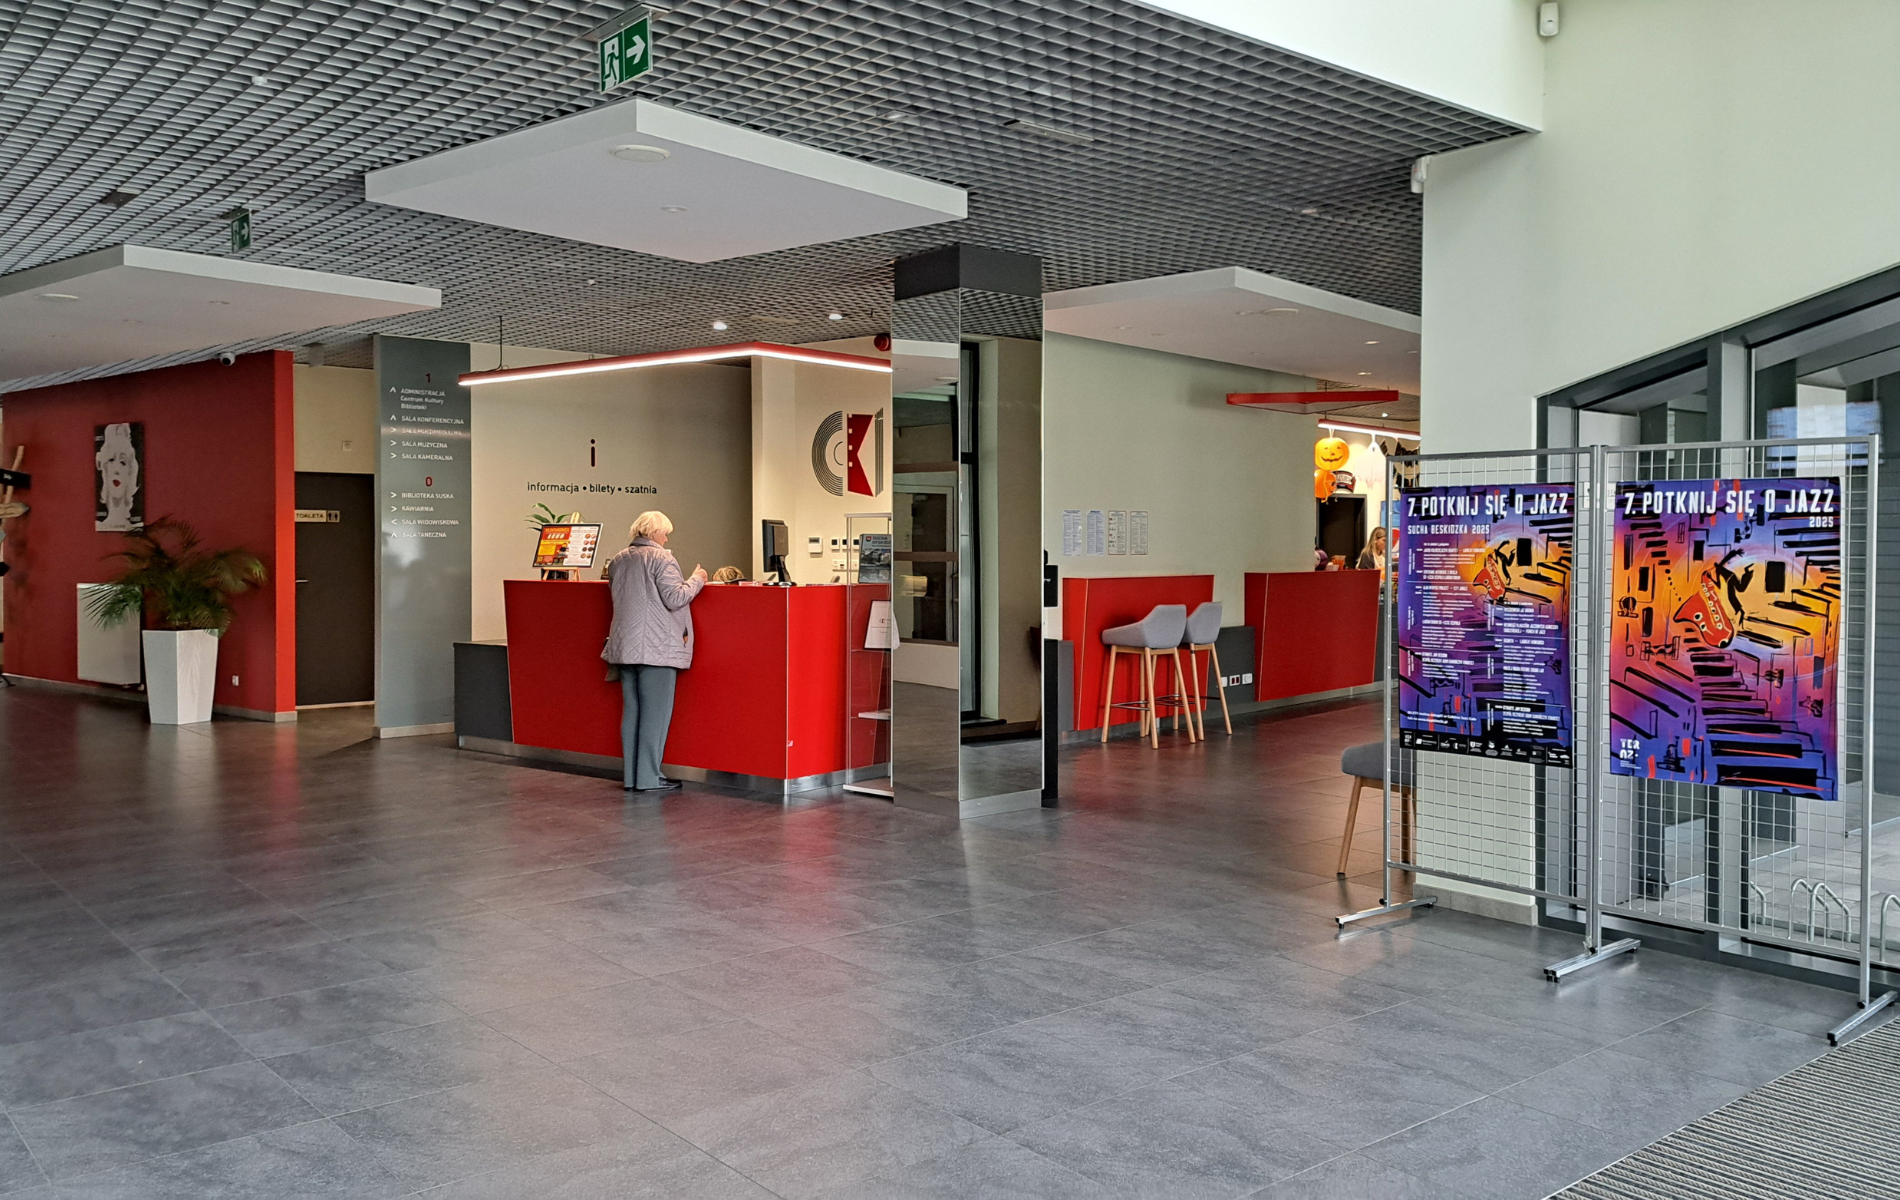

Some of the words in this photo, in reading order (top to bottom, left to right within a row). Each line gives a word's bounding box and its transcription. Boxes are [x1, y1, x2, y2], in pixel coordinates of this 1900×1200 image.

[425, 373, 431, 383] 1
[417, 417, 465, 425] KONFERENCYJNA
[417, 441, 448, 449] MUZYCZNA
[590, 438, 596, 467] i
[527, 481, 580, 494] informacja
[589, 483, 616, 495] bilety
[624, 485, 657, 494] szatnia
[1407, 497, 1418, 517] 7.
[1421, 495, 1479, 516] POTKNIJ
[1485, 494, 1508, 518] SIĘ
[1514, 493, 1524, 514] O
[1529, 492, 1569, 515] JAZZ
[1624, 492, 1636, 515] 7.
[1642, 490, 1717, 514] POTKNIJ
[1724, 489, 1756, 517] SIĘ
[1765, 489, 1776, 513] O
[1785, 488, 1835, 513] JAZZ
[1809, 516, 1834, 528] 2025
[1407, 524, 1429, 535] SUCHA
[1430, 524, 1468, 535] BESKIDZKA
[1471, 524, 1490, 535] 2025
